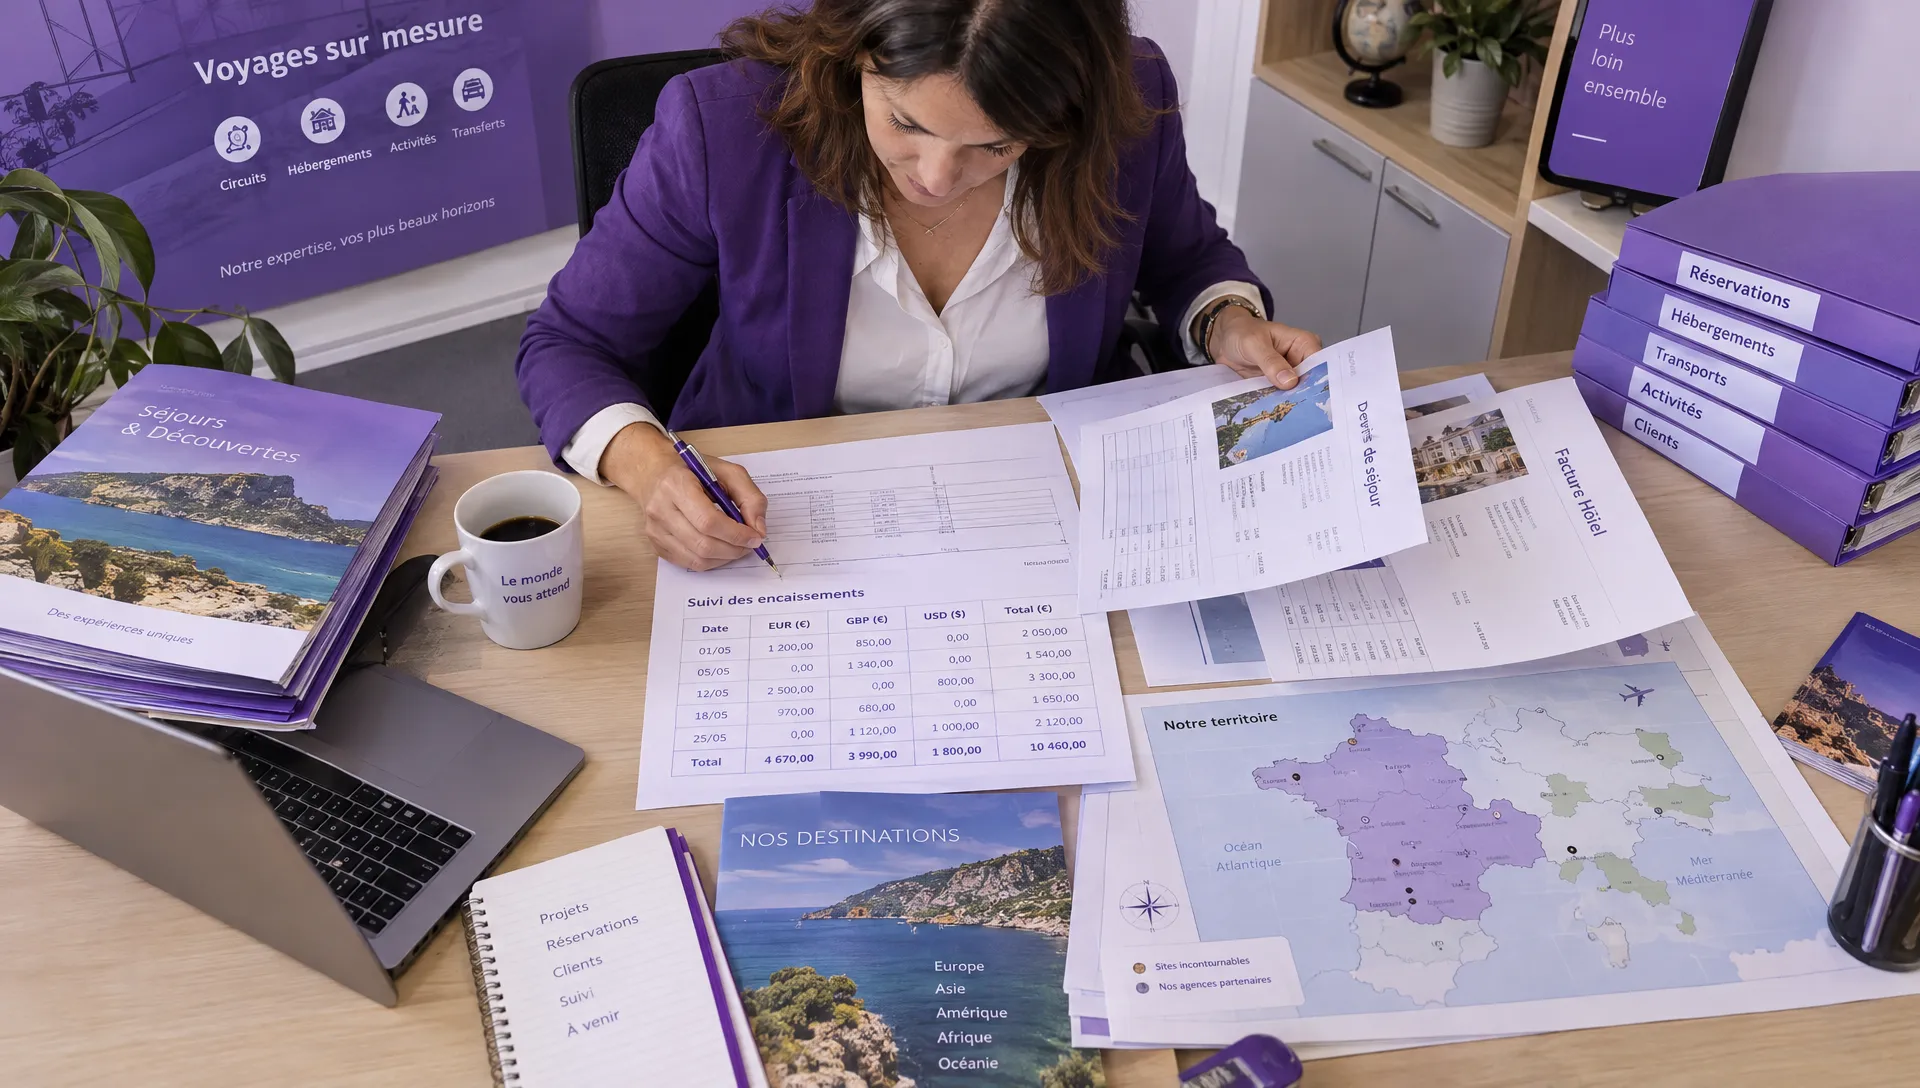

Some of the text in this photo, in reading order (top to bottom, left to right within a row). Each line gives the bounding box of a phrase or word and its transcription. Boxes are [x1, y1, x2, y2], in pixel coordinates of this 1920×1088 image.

[1599, 22, 1635, 46] Plus
[194, 13, 483, 85] Voyages sur mesure
[1591, 49, 1623, 71] loin
[1584, 79, 1667, 110] ensemble
[452, 118, 506, 138] Transferts
[390, 133, 437, 152] Activités
[288, 148, 372, 176] Hébergements
[220, 172, 266, 191] Circuits
[220, 197, 495, 278] Notre expertise, vos plus beaux horizons
[1689, 265, 1790, 310] Réservations
[1670, 307, 1776, 358] Hébergements
[1656, 346, 1727, 386] Transports
[1640, 381, 1703, 420] Activités
[138, 405, 227, 430] Séjours
[121, 421, 300, 464] & Découvertes
[1634, 417, 1679, 451] Clients
[1364, 447, 1376, 464] de
[501, 565, 563, 586] Le monde
[503, 578, 570, 604] vous attend
[687, 589, 865, 607] Suivi des encaissements
[47, 607, 194, 645] Des expériences uniques
[702, 625, 729, 633] Date
[768, 621, 792, 630] EUR
[846, 616, 869, 625] GBP
[924, 611, 947, 620] USD
[951, 610, 966, 620] ($)
[1004, 605, 1033, 614] Total
[699, 647, 731, 655] 01/05
[856, 638, 892, 647] 850,00
[946, 633, 969, 643] 0,00
[697, 667, 730, 677] 05/05
[791, 664, 814, 673] 0,00
[949, 655, 971, 664] 0,00
[697, 689, 729, 698] 12/05
[872, 681, 895, 691] 0,00
[937, 677, 974, 686] 800,00
[695, 711, 728, 720] 18/05
[777, 707, 814, 717] 970,00
[858, 703, 896, 713] 680,00
[954, 698, 977, 708] 0,00
[1163, 711, 1278, 732] Notre territoire
[693, 734, 727, 743] 25/05
[791, 730, 814, 740] 0,00
[691, 758, 722, 767] Total
[740, 827, 960, 848] NOS DESTINATIONS
[1224, 840, 1262, 853] Océan
[1216, 857, 1282, 873] Atlantique
[1690, 856, 1713, 867] Mer
[1676, 870, 1753, 886] Méditerranée
[540, 903, 589, 924] Projets
[546, 915, 639, 951] Réservations
[553, 956, 603, 978] Clients
[934, 961, 985, 974] Europe
[1155, 962, 1177, 971] Sites
[935, 983, 966, 994] Asie
[1159, 976, 1272, 991] Nos agences partenaires
[560, 987, 595, 1008] Suivi
[567, 1010, 620, 1038] À venir
[936, 1006, 1008, 1021] Amérique
[937, 1031, 992, 1046] Afrique
[938, 1056, 999, 1070] Océanie
